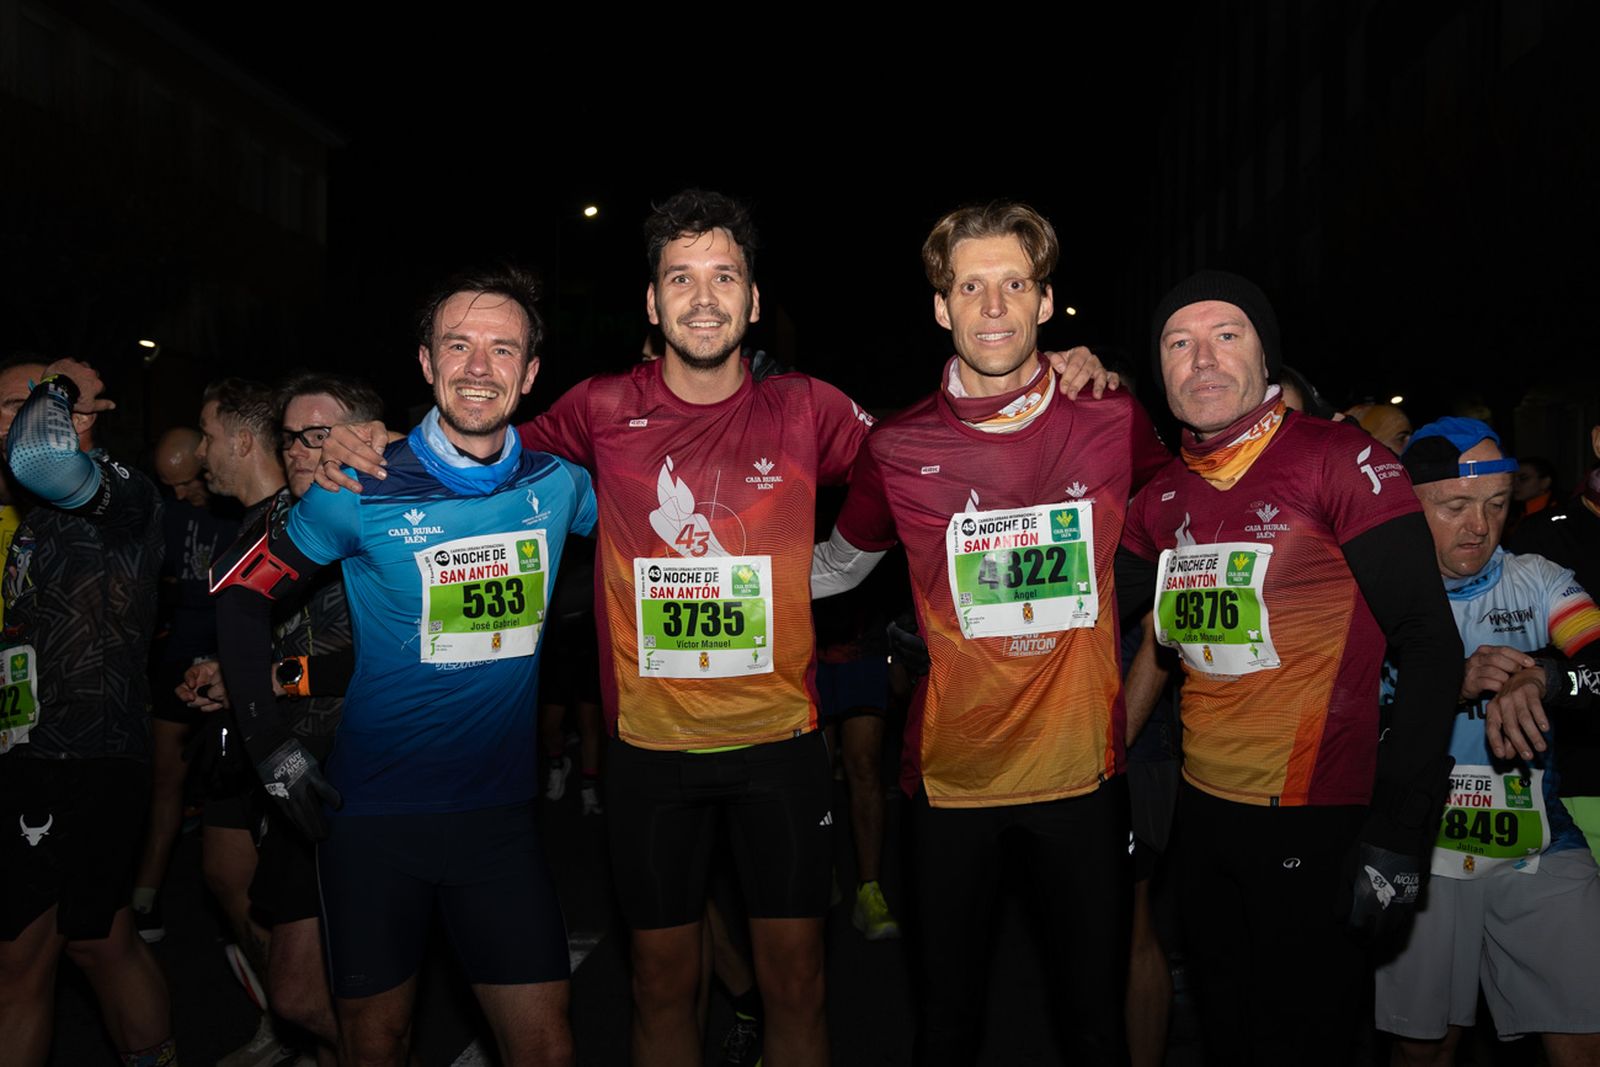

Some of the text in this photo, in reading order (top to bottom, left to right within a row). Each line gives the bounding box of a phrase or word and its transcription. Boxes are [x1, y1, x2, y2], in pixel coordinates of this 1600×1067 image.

[388, 525, 445, 537] CAJA RURAL
[979, 517, 1037, 535] NOCHE DE
[1262, 523, 1290, 532] RURAL
[675, 524, 710, 557] 43
[964, 530, 1039, 553] SAN ANTÓN
[453, 548, 507, 565] NOCHE DE
[1177, 557, 1218, 572] NOCHE DE
[440, 569, 466, 584] SAN
[469, 561, 508, 581] ANTÓN
[977, 545, 1069, 590] 4322
[664, 572, 719, 583] NOCHE DE
[1167, 577, 1185, 590] SAN
[462, 577, 526, 619] 533
[650, 583, 720, 599] SAN ANTÓN
[1175, 590, 1239, 630] 9376
[470, 617, 520, 631] José Gabriel
[663, 601, 745, 637] 3735
[701, 639, 731, 648] Manuel
[1448, 779, 1491, 791] CHE DE
[1443, 791, 1492, 807] ANTÓN
[1441, 809, 1518, 847] 849
